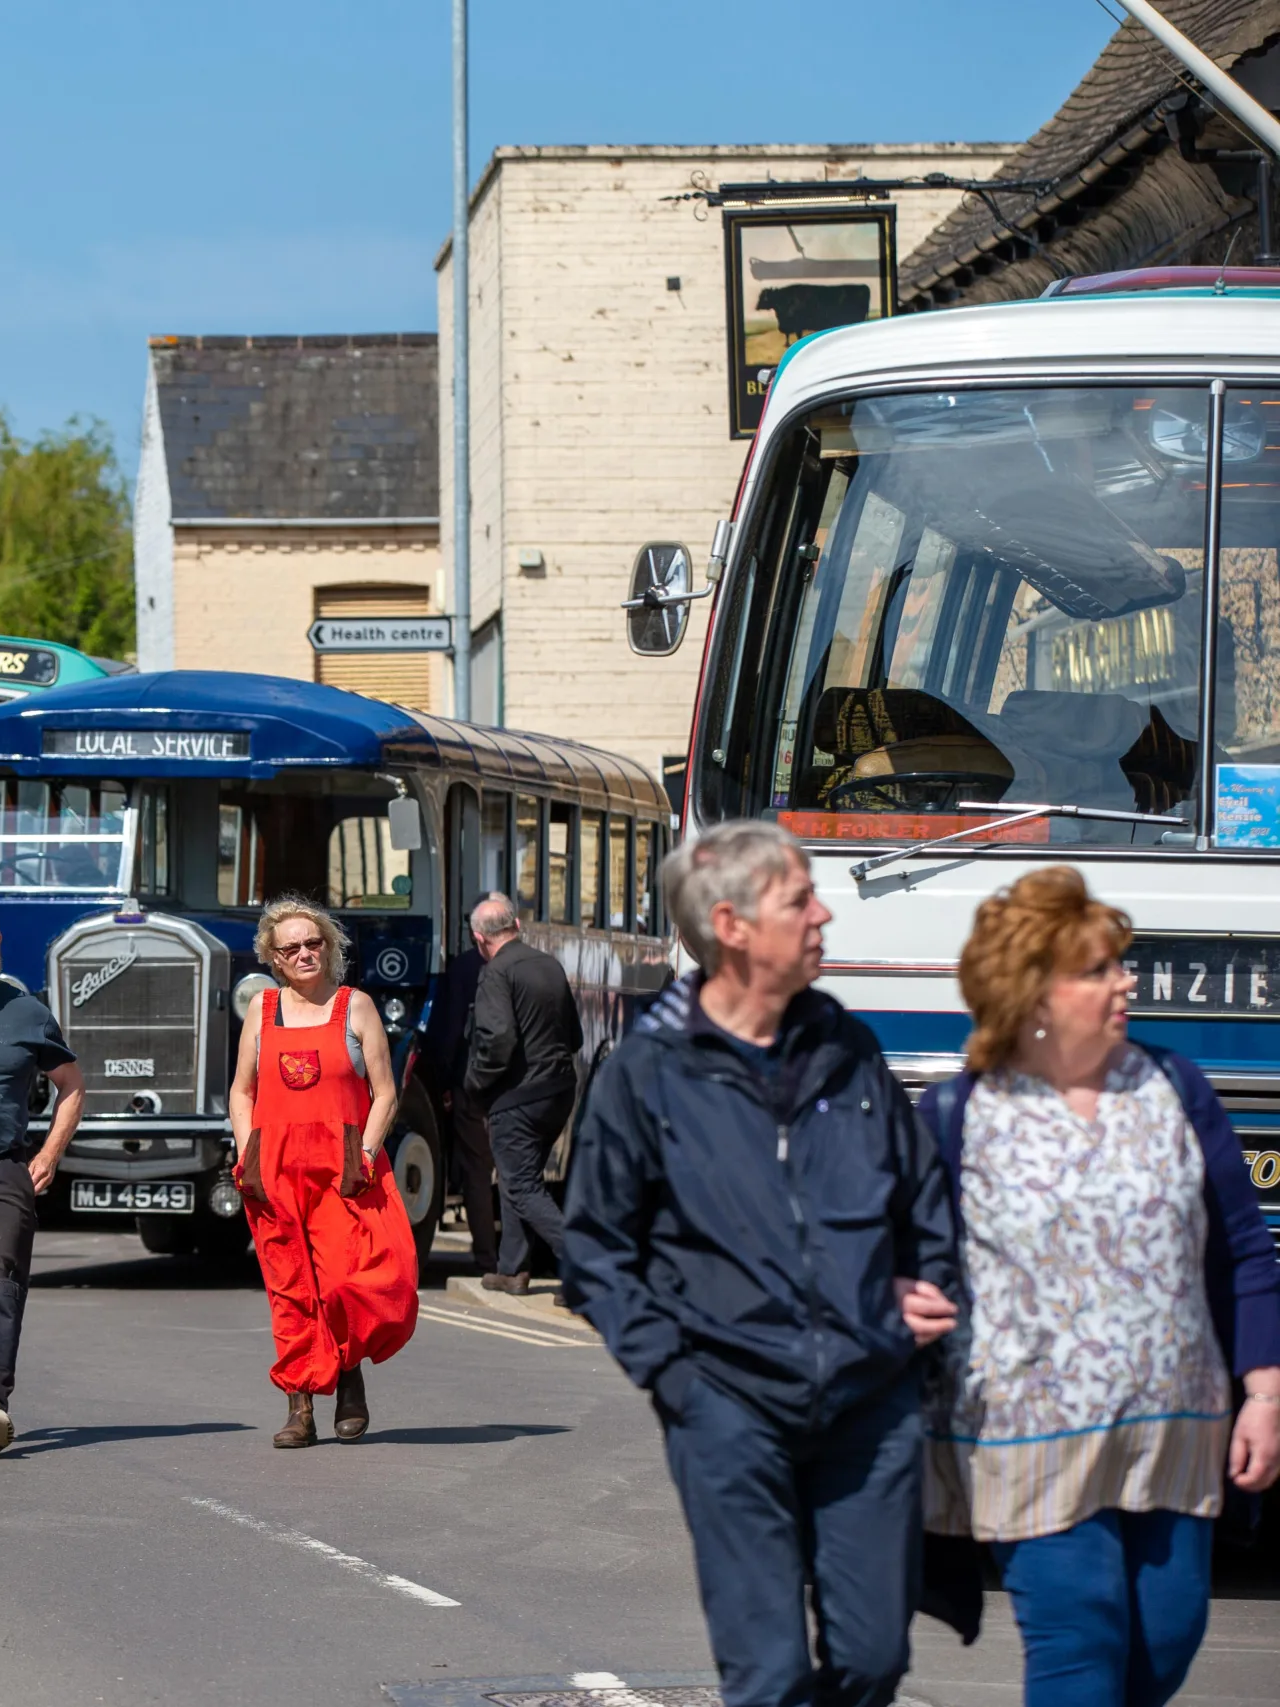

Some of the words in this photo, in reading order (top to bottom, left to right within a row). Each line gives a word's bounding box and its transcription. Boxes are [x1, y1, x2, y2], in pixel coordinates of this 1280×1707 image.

[331, 626, 386, 640] Health
[391, 627, 444, 640] centre
[76, 731, 137, 754] LOCAL
[151, 733, 234, 757] SERVICE
[1231, 783, 1264, 795] Memory
[1218, 811, 1262, 822] Kenzie
[837, 822, 929, 839] FOWLER
[971, 825, 1034, 841] SONS
[381, 952, 402, 977] 6
[77, 1184, 112, 1207] MJ
[117, 1184, 187, 1208] 4549
